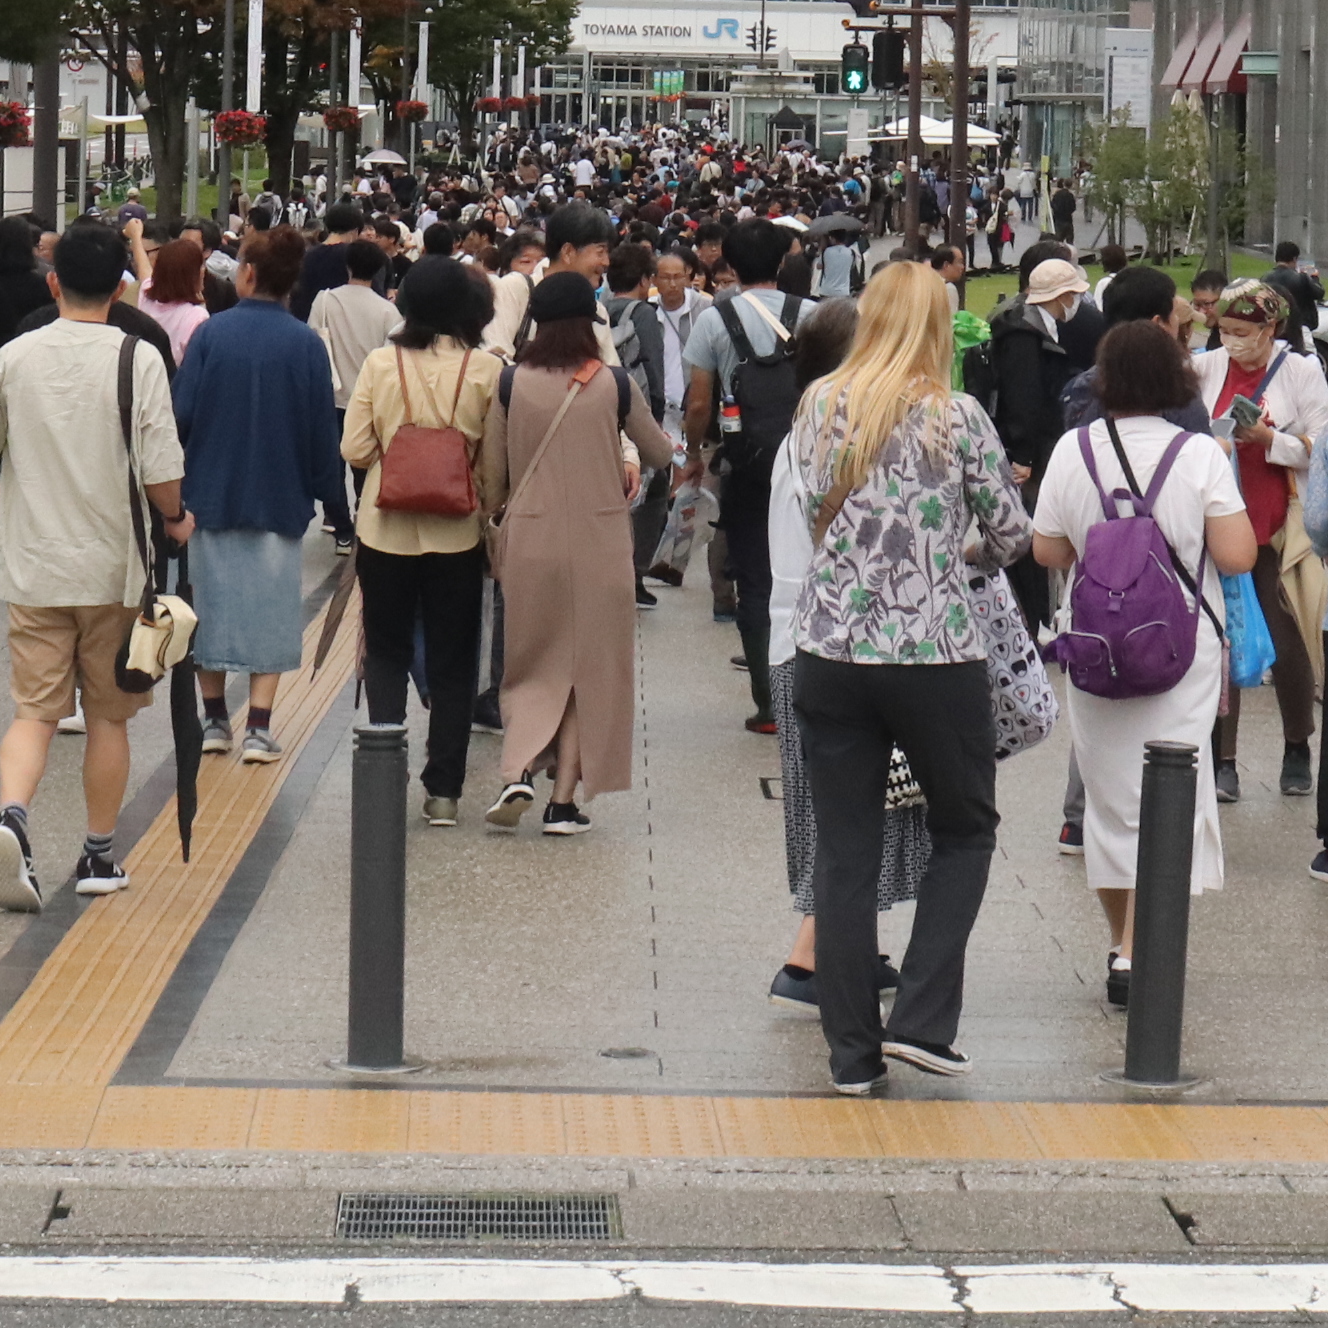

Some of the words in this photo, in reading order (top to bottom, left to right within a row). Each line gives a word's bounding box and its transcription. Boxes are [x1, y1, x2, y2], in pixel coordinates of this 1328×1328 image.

[583, 24, 638, 37] TOYAMA
[642, 25, 692, 38] STATION
[702, 17, 740, 39] JR
